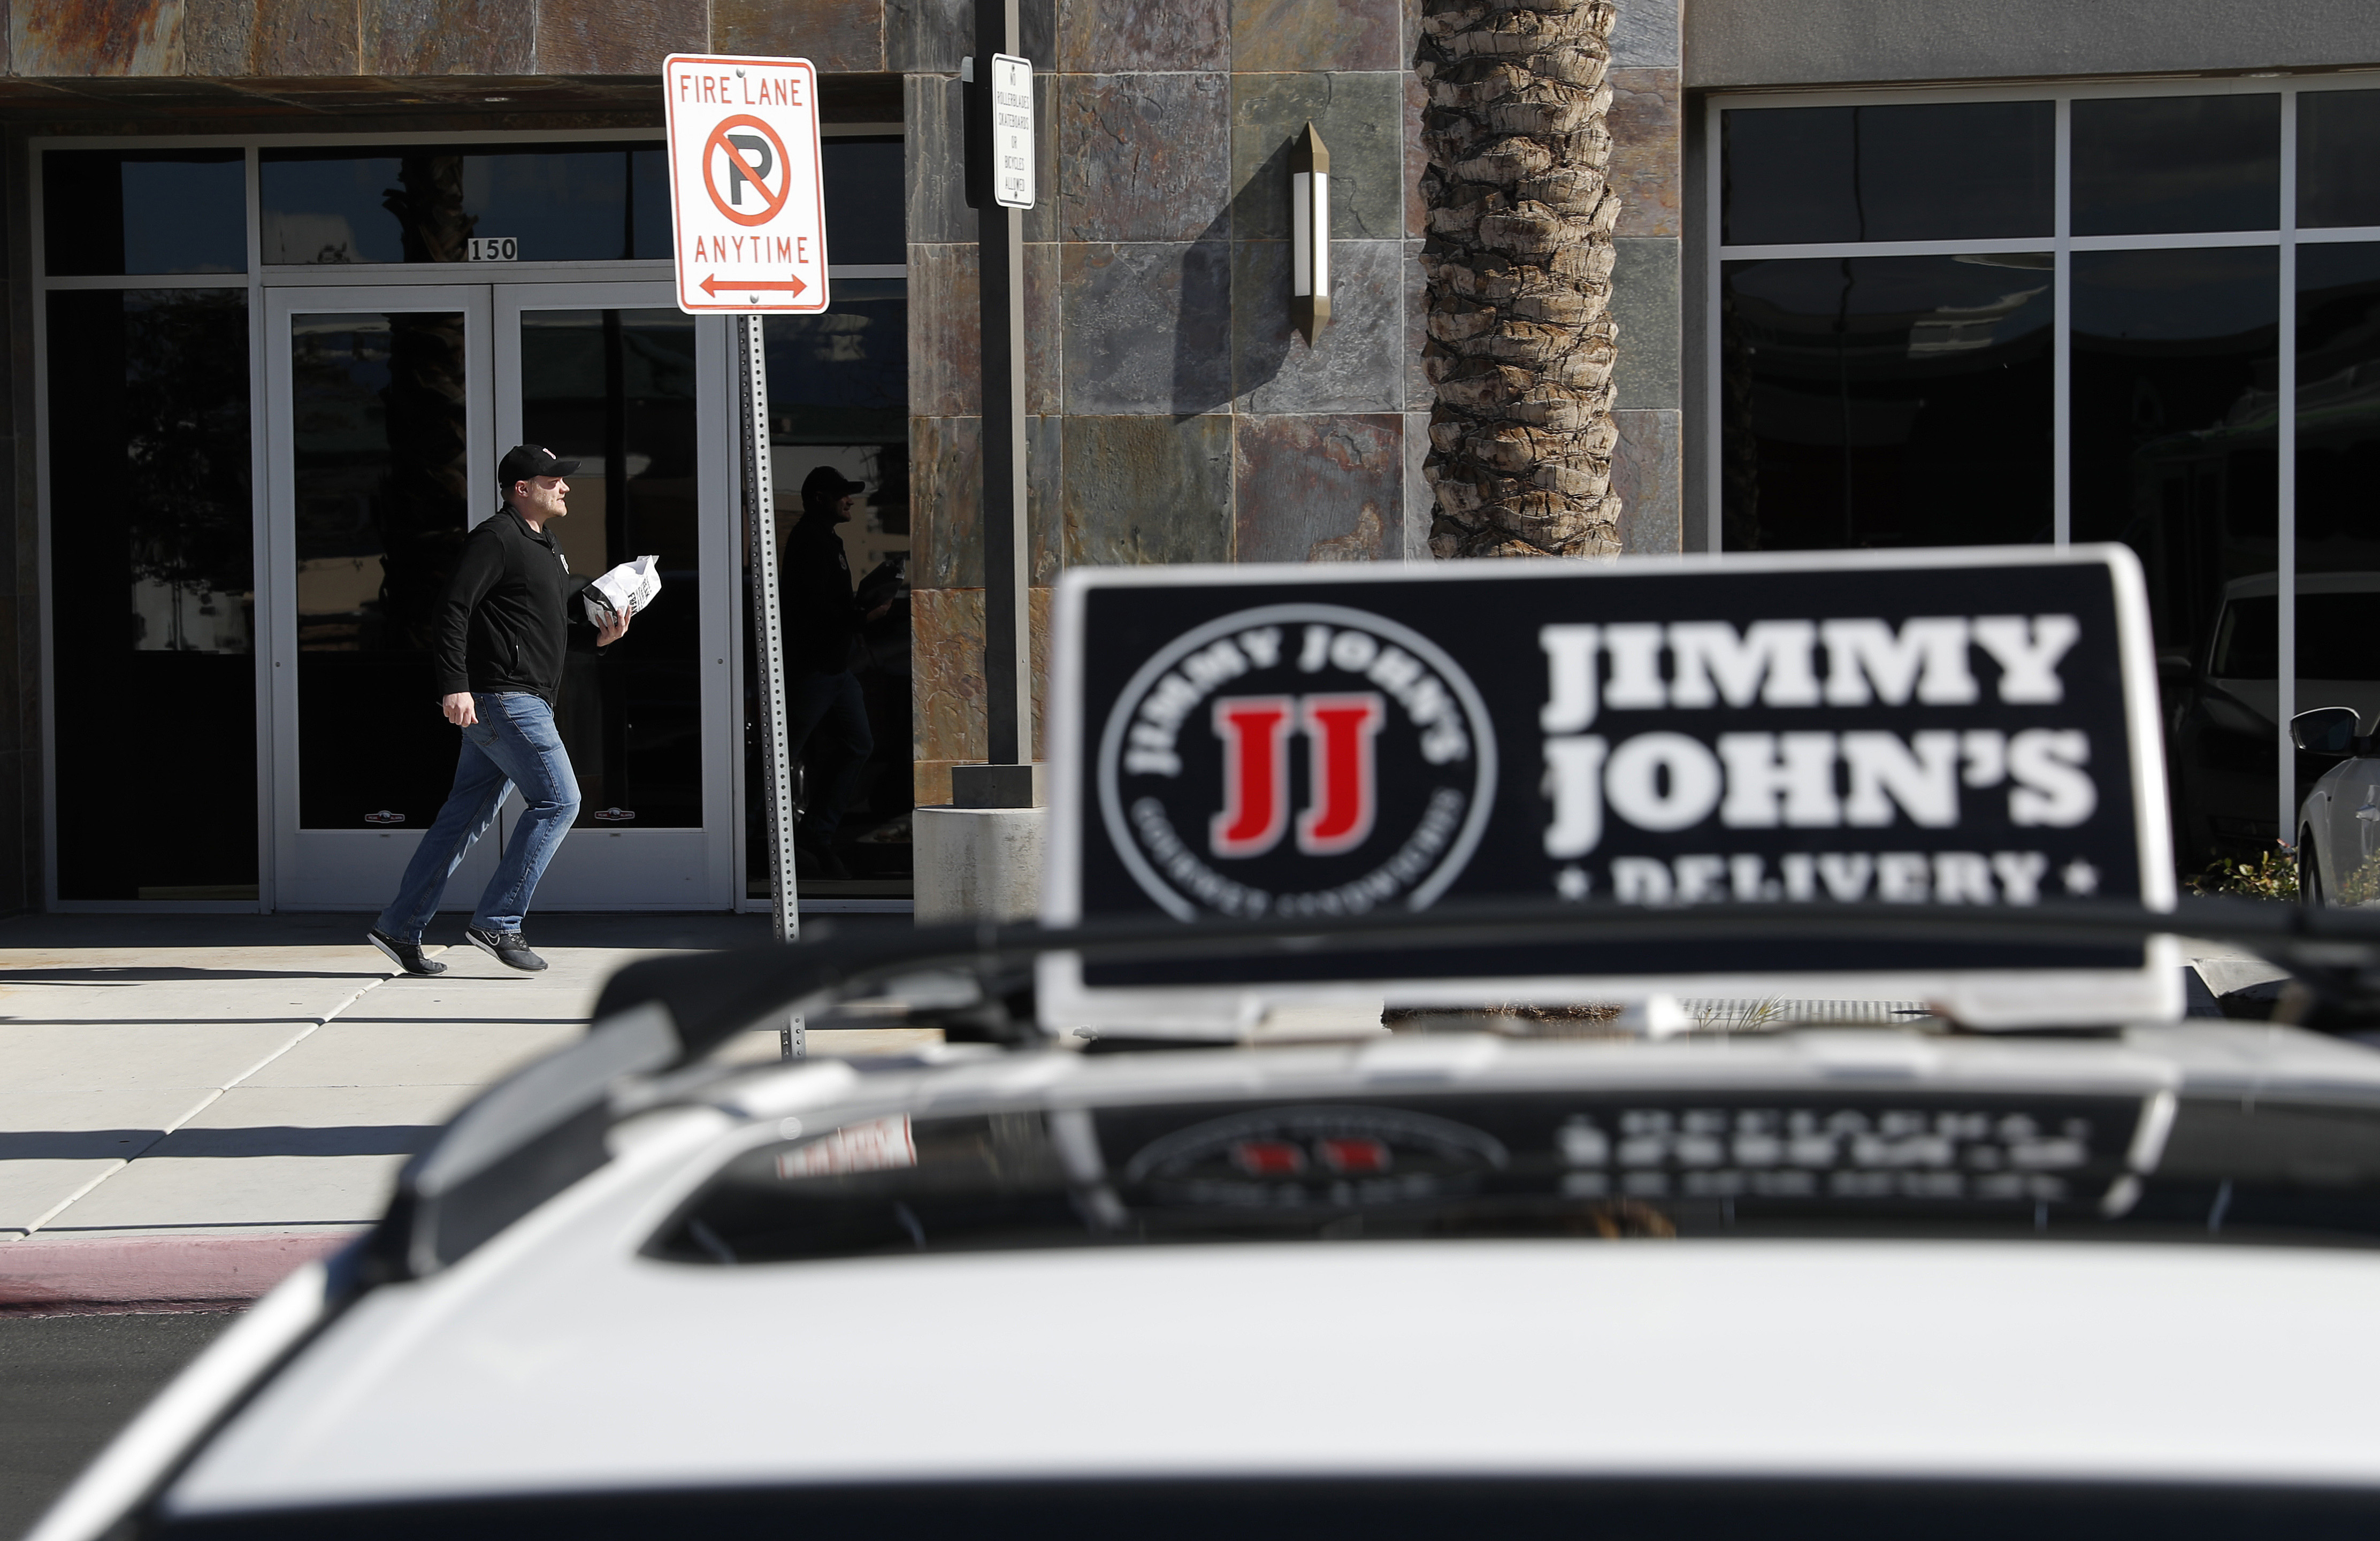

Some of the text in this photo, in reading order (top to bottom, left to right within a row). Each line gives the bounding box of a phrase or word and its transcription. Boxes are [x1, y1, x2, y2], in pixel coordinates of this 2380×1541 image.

[680, 74, 803, 107] FIRE LANE
[997, 91, 1029, 109] ROLLERBLADES
[998, 112, 1029, 130] SKATEBOARDS
[1011, 135, 1017, 149] OR
[1004, 155, 1024, 171] BICYCLES
[1005, 177, 1025, 191] ALLOWED
[472, 239, 516, 260] 150
[694, 235, 809, 264] ANYTIME
[1540, 613, 2081, 734] JIMMY
[1122, 623, 1470, 778] JIMMY JOHN'S
[1208, 691, 1387, 859] JJ
[1543, 727, 2099, 858] JOHN'S
[1610, 851, 2049, 907] DELIVERY
